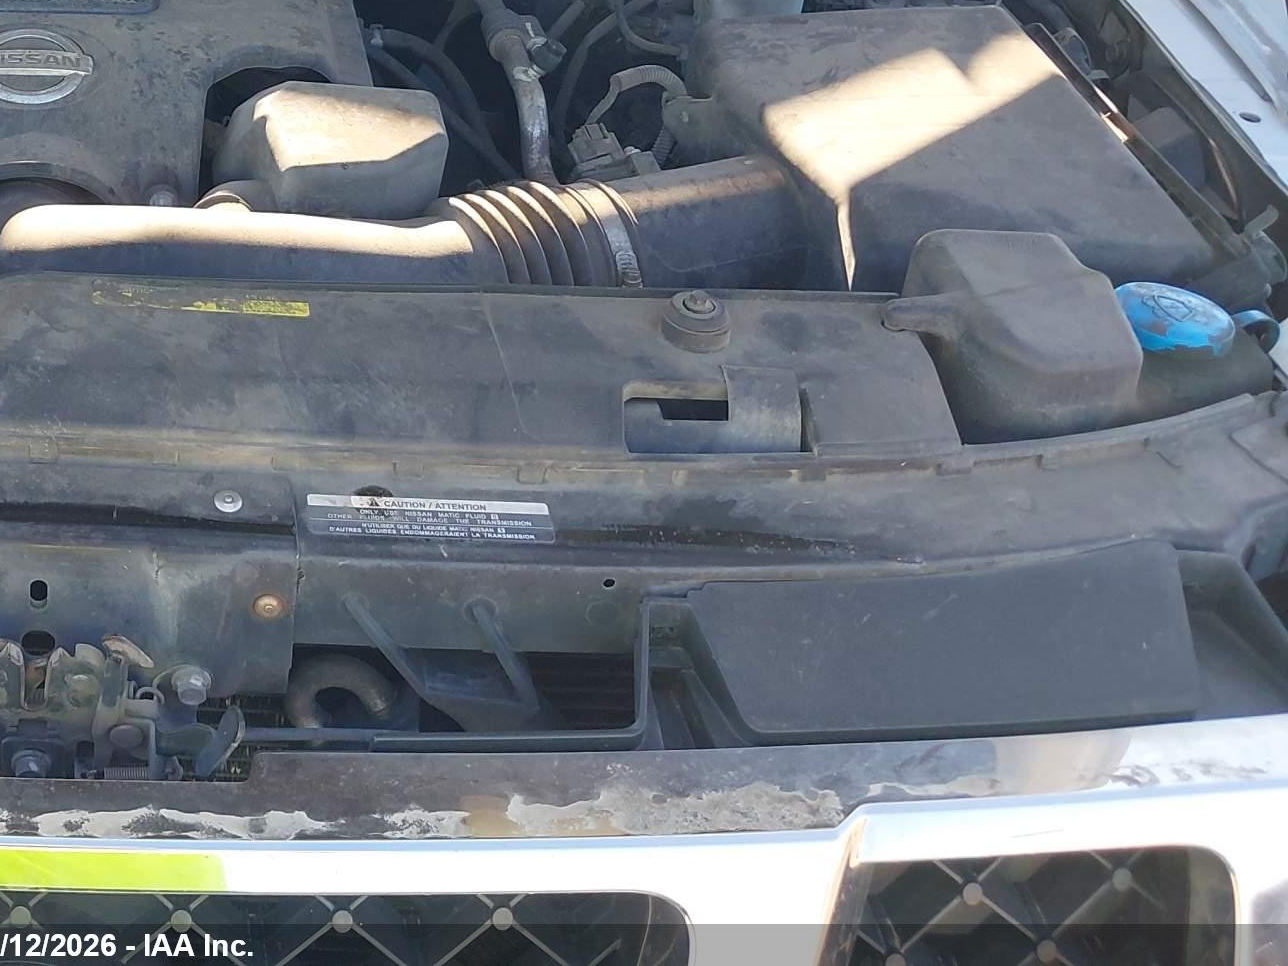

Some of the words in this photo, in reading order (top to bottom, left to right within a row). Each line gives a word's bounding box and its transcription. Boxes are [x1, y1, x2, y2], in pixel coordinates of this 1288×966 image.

[383, 500, 426, 509] CAUTION
[435, 502, 487, 511] ATTENTION
[483, 532, 536, 540] TRANSMISSION
